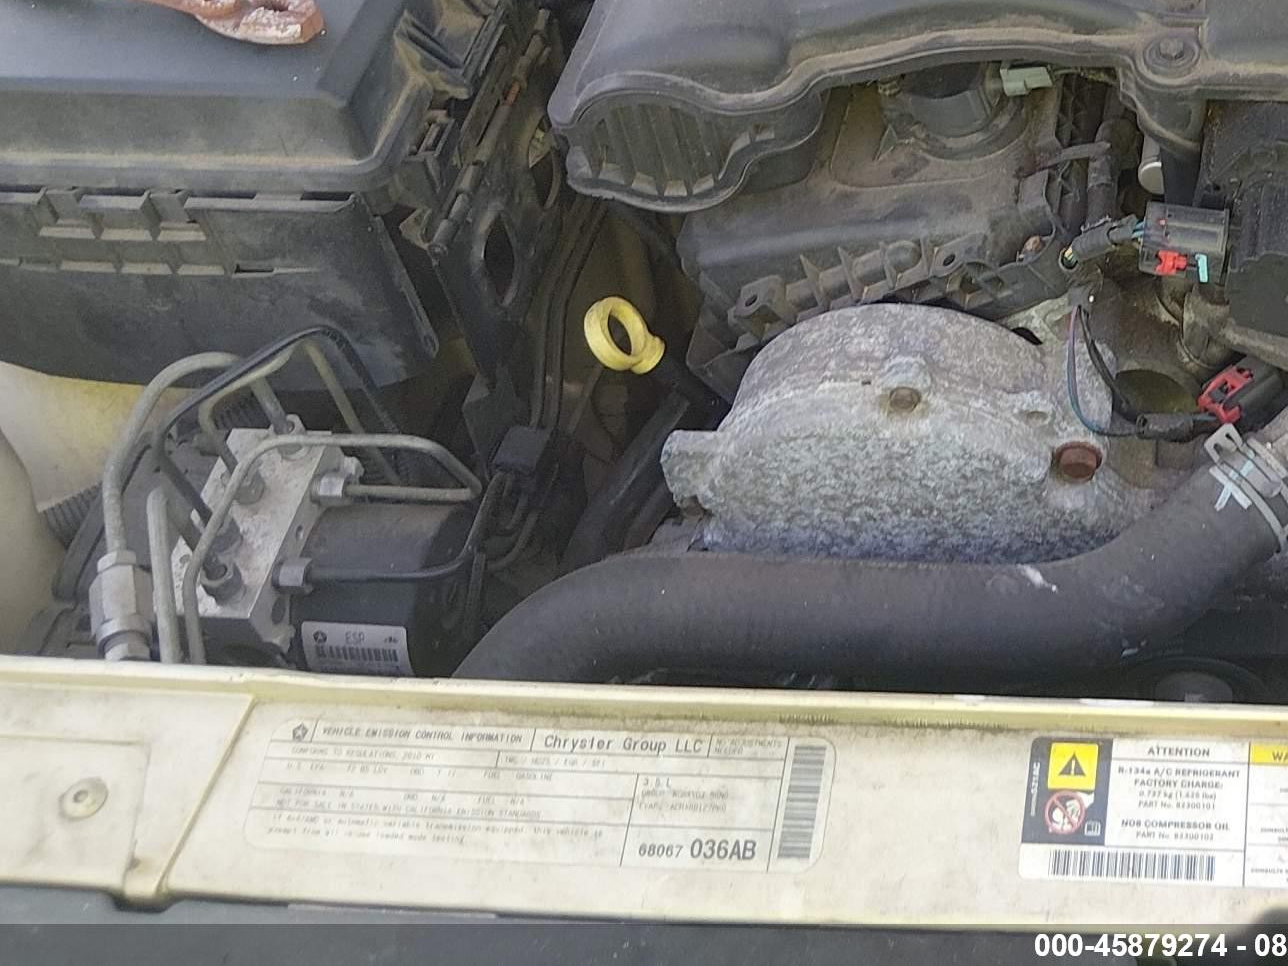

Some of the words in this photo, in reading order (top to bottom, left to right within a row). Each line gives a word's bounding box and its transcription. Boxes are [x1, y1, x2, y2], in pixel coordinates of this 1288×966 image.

[322, 727, 358, 737] VEHICLE
[364, 728, 411, 739] EMISSION
[415, 730, 453, 740] CONTROL
[461, 732, 522, 743] INFORMATION
[544, 734, 613, 753] Chrysler
[623, 737, 666, 756] Group
[675, 739, 702, 753] LLC
[1147, 745, 1211, 757] ATTENTION
[1154, 767, 1173, 777] A/C
[1175, 768, 1241, 779] REFRIGERANT
[1134, 778, 1178, 788] FACTORY
[1138, 801, 1158, 809] PART
[1144, 820, 1212, 831] COMPRESSOR
[1136, 831, 1156, 839] PART
[639, 843, 683, 857] 68067
[690, 838, 757, 860] 036AB
